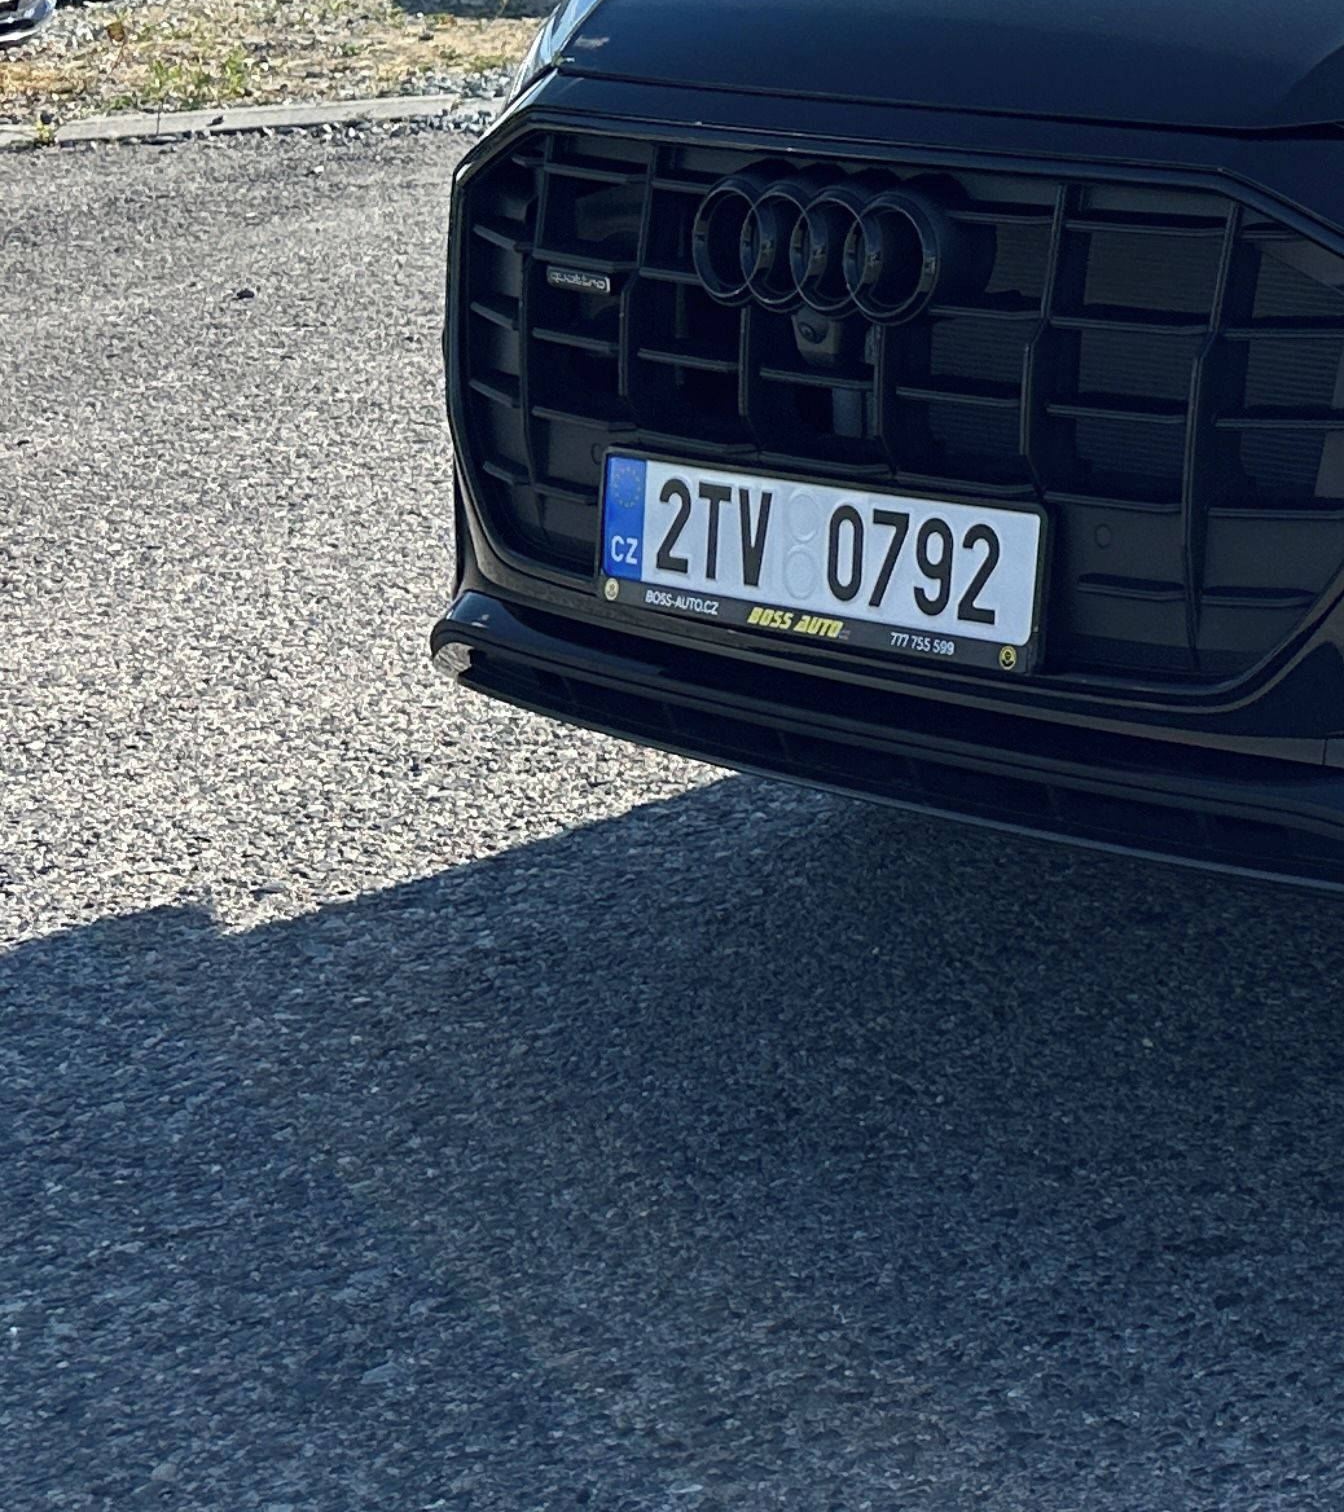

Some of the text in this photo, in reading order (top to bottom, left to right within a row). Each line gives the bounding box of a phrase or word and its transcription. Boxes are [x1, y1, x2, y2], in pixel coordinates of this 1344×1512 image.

[610, 478, 1001, 626] CZ 2TV 0792
[645, 589, 720, 615] BOSS-AUTO.CZ
[747, 606, 794, 631] BOSS
[794, 615, 844, 638] AUTO
[889, 631, 909, 648] 777
[911, 635, 931, 652] 755
[932, 639, 955, 656] 599
